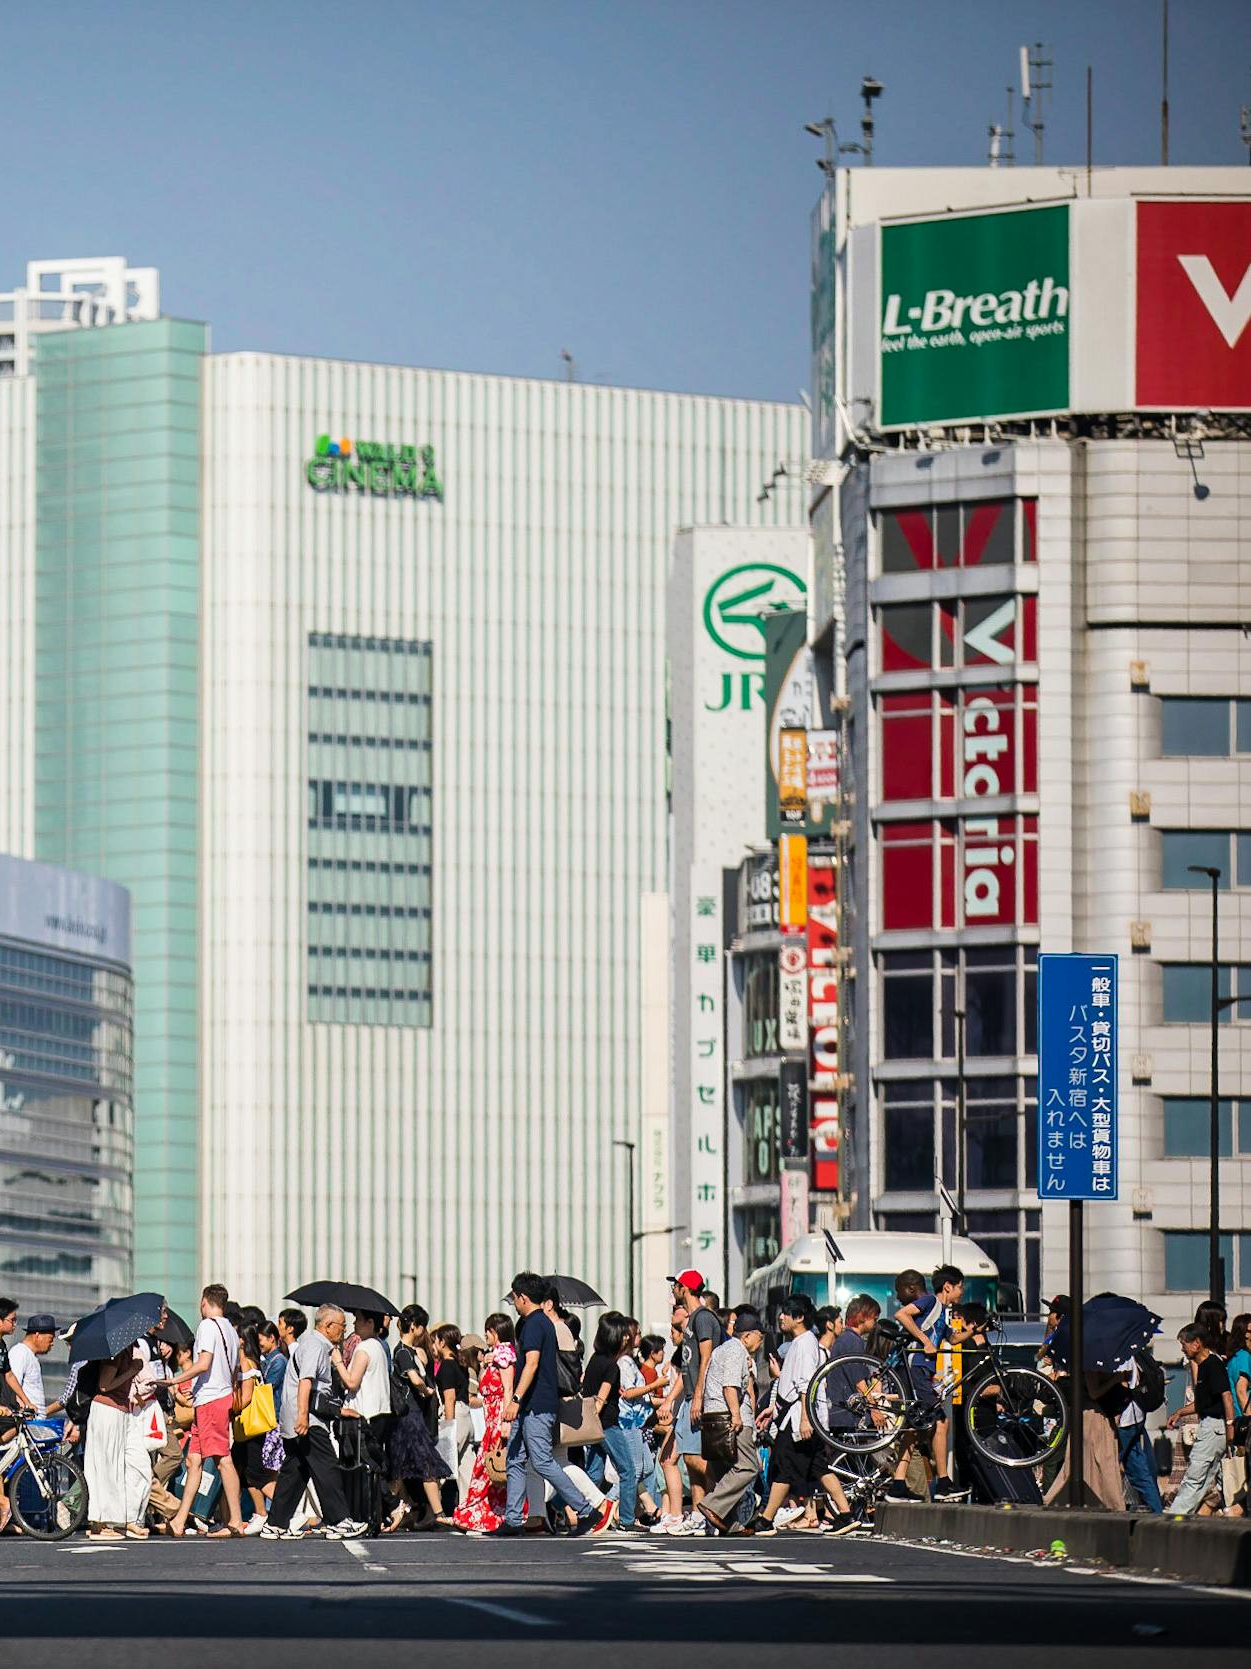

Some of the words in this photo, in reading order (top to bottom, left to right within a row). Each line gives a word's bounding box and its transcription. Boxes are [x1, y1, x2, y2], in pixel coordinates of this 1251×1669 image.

[883, 277, 1069, 336] L-Breath
[307, 457, 444, 500] CINEMA
[705, 671, 766, 711] JR
[964, 599, 1015, 917] Vctoria
[1068, 1004, 1088, 1150] バスタ新宿へは
[1091, 966, 1111, 1192] 一般車・貸切バス・大型貨物車は
[1046, 1088, 1066, 1191] 入れません
